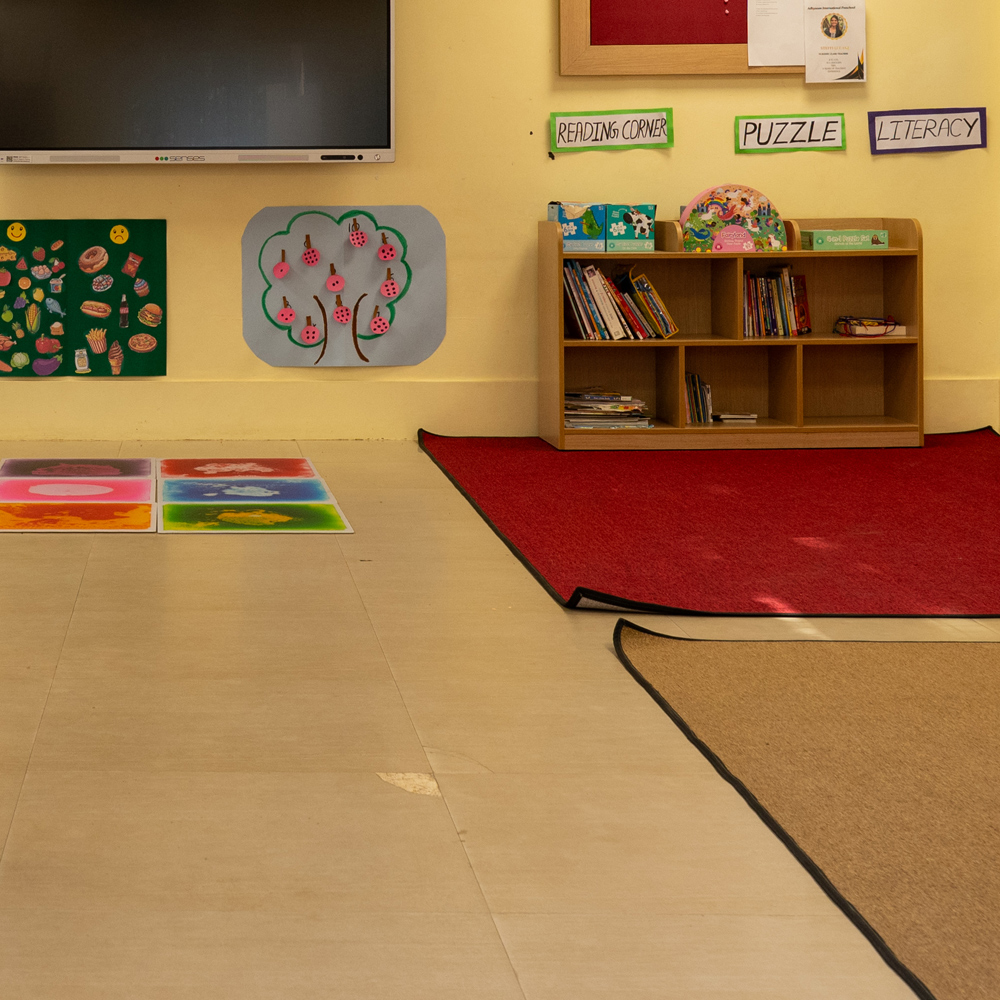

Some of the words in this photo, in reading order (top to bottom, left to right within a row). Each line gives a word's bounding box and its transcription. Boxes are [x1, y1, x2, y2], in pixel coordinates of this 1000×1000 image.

[557, 120, 619, 144] READING
[622, 117, 668, 140] CORNER
[743, 120, 839, 146] PUZZLE
[877, 116, 980, 142] LITERACY
